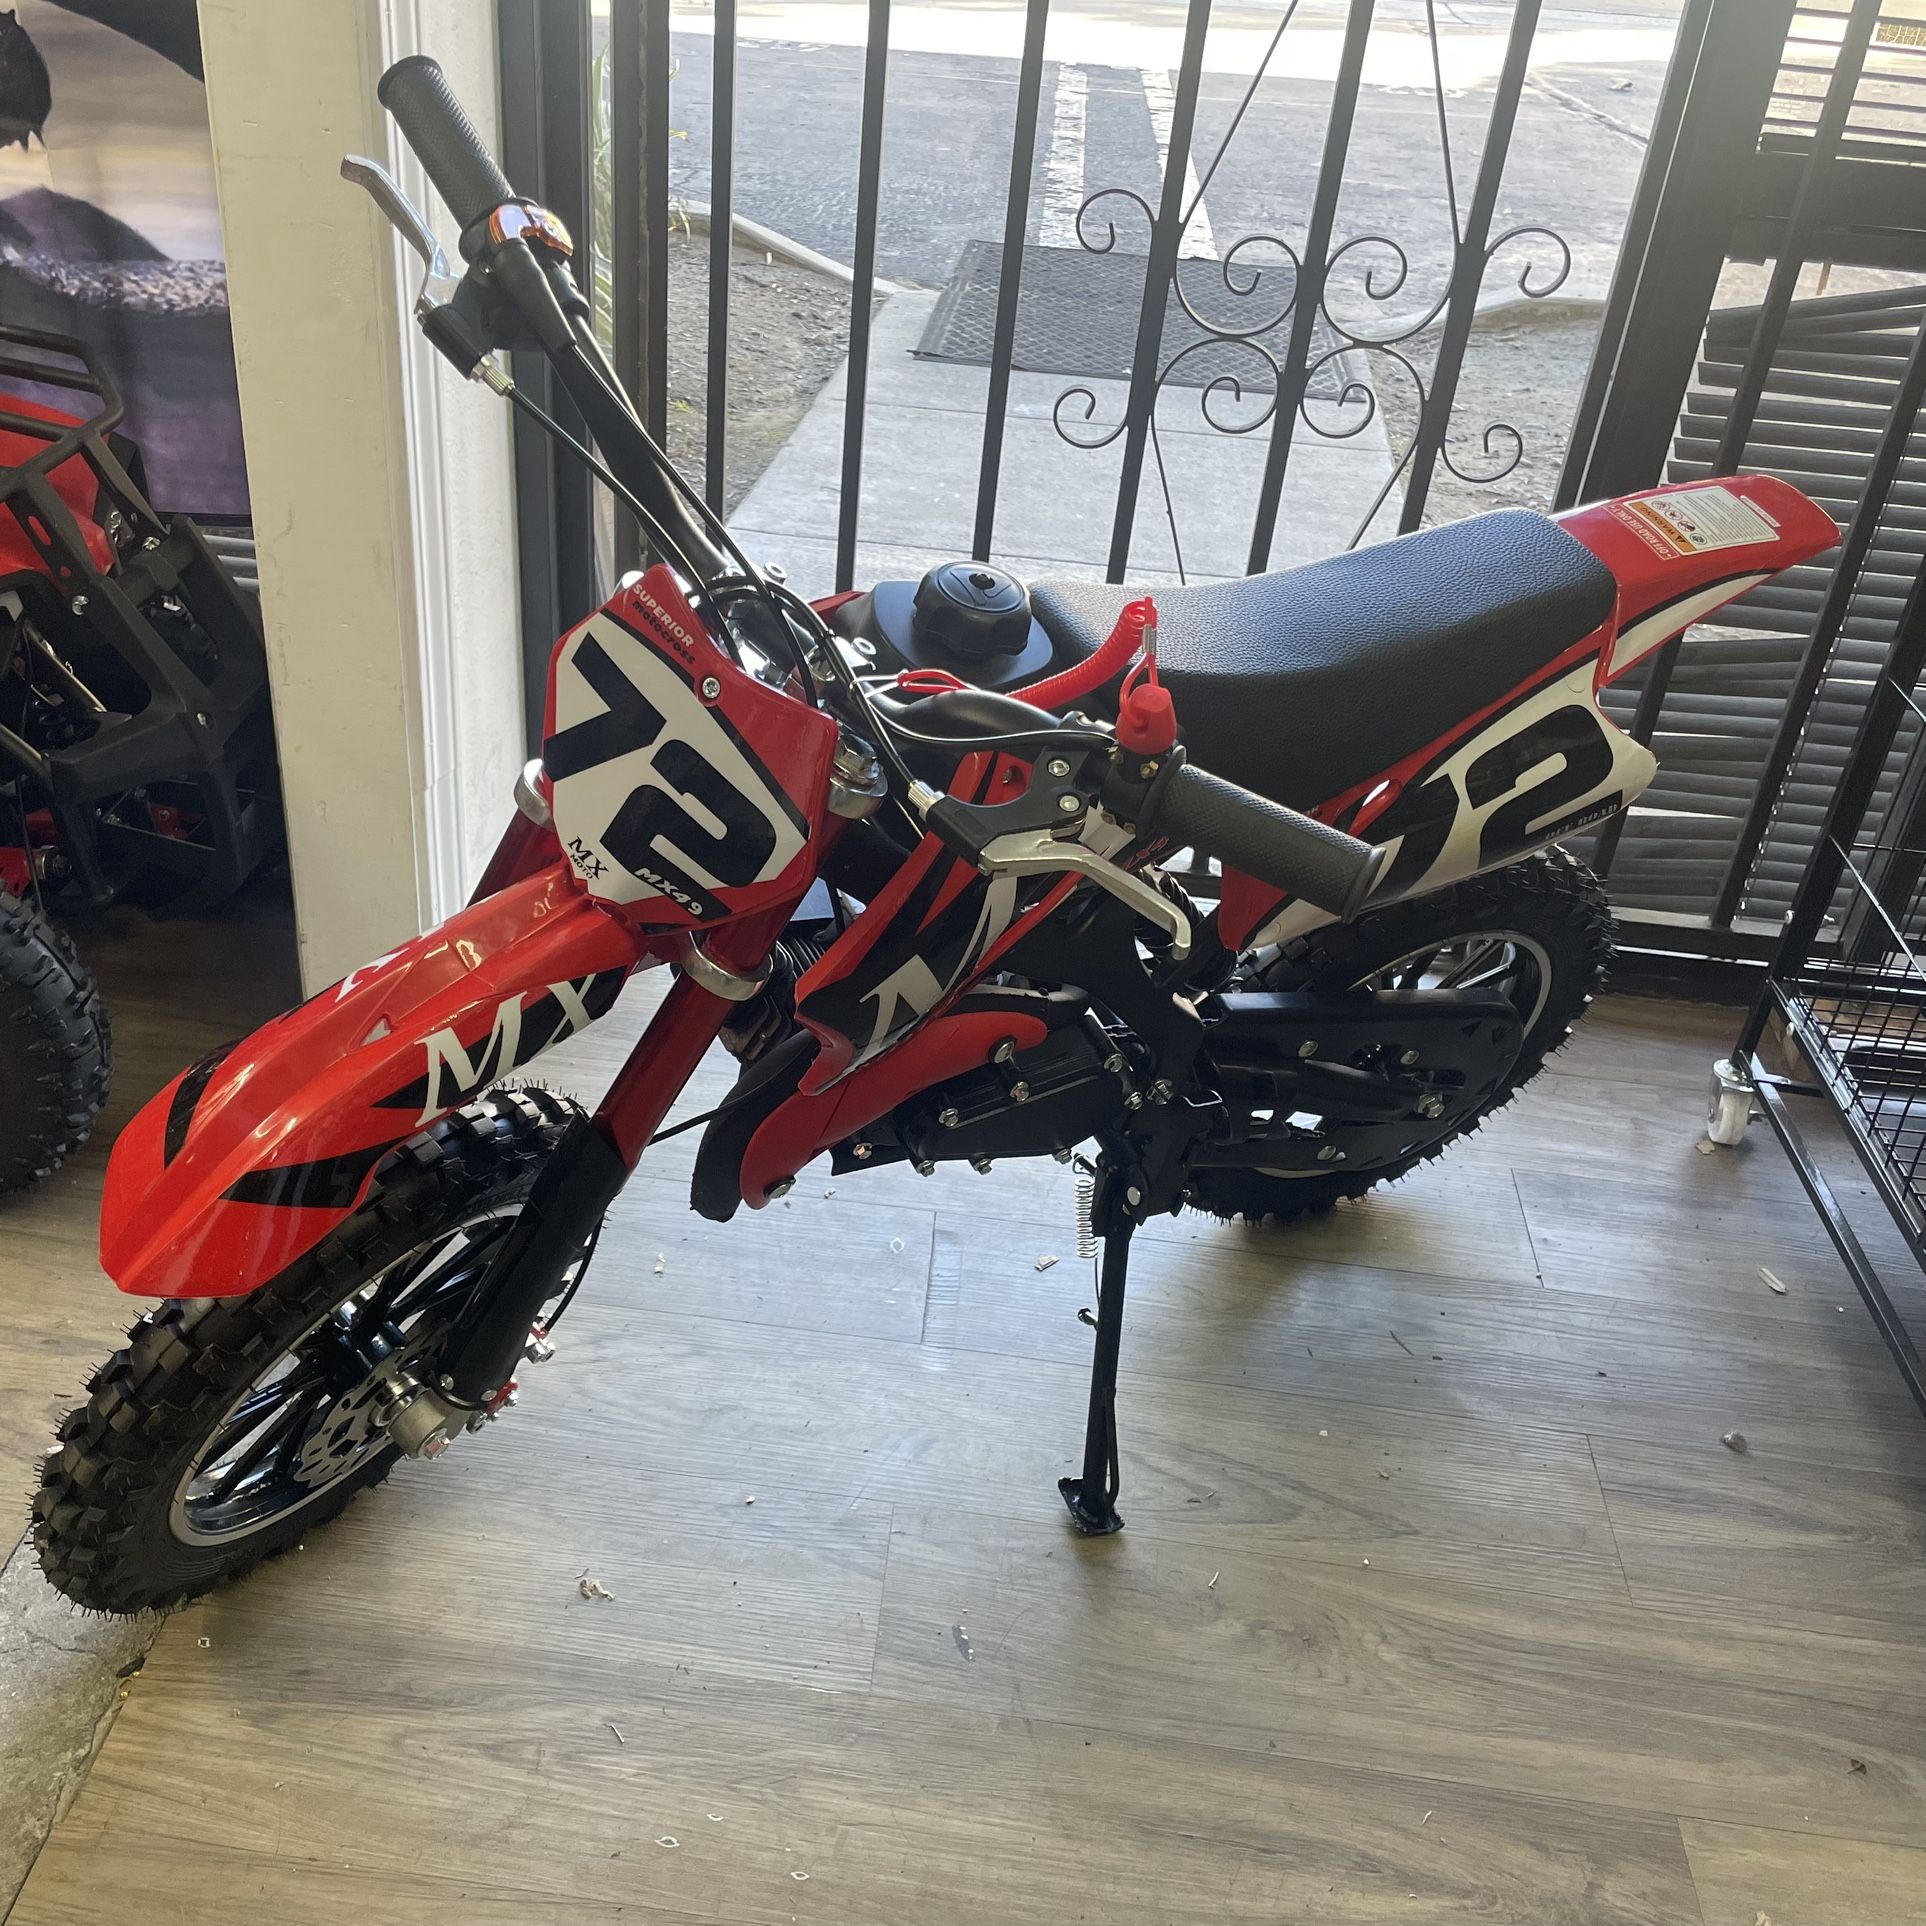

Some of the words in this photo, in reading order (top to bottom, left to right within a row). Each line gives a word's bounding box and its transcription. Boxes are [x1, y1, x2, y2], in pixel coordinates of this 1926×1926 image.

[1639, 506, 1676, 536] WARNING
[631, 600, 696, 665] motocross
[632, 583, 695, 648] SUPERIOR
[543, 631, 778, 922] 72
[567, 835, 610, 880] MX
[570, 854, 594, 880] MOTO
[633, 867, 703, 916] MX49
[414, 972, 598, 1128] MX
